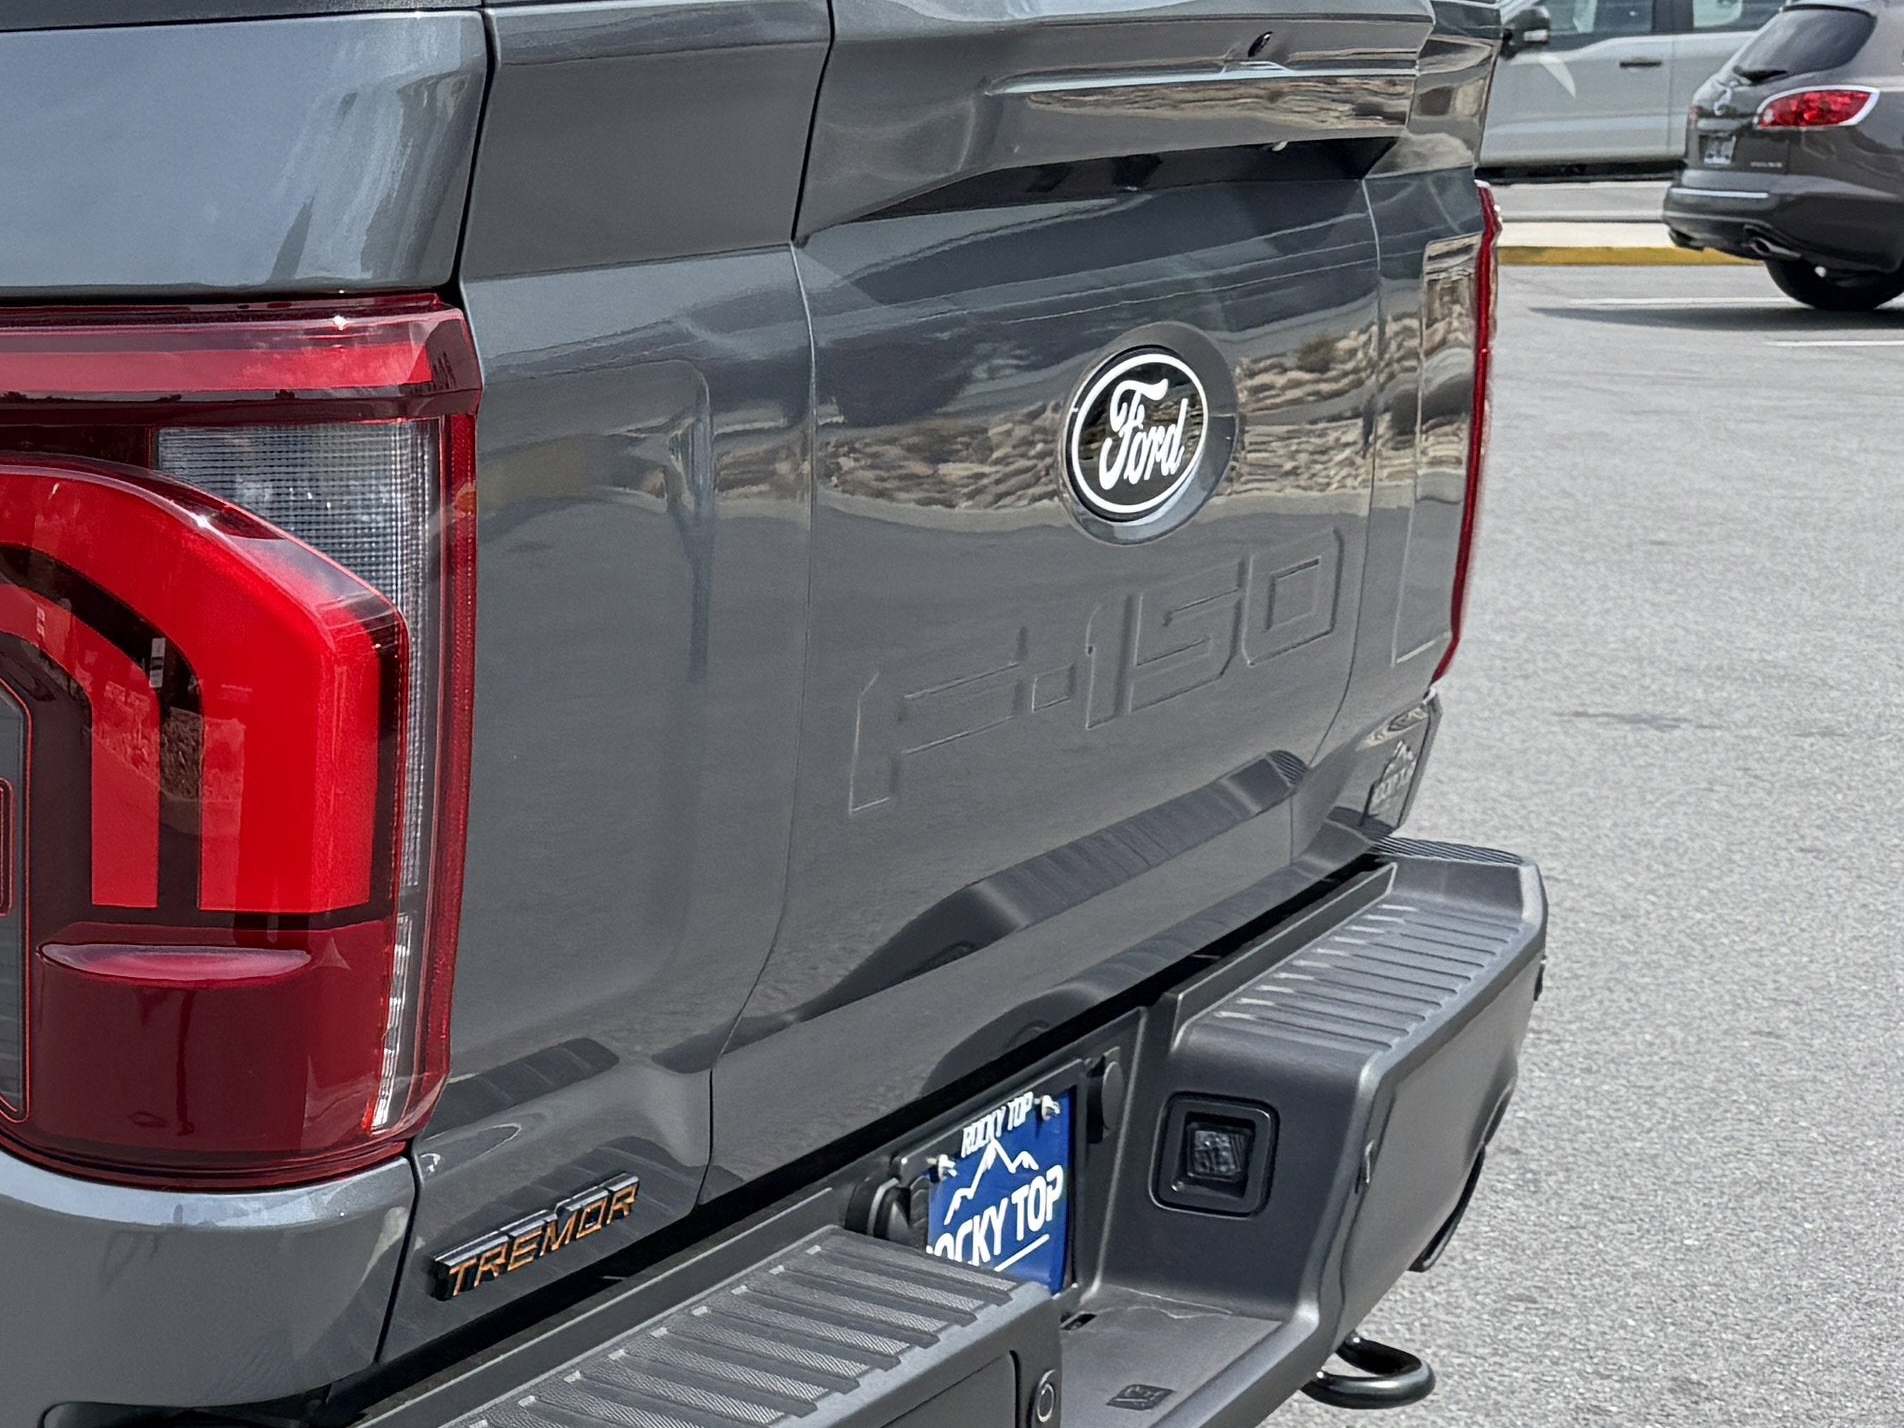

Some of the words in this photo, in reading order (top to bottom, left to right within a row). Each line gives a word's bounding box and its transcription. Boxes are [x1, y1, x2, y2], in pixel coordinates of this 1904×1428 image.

[1098, 378, 1189, 490] Ford
[960, 1105, 1006, 1159] ROCKY
[1007, 1091, 1034, 1131] TOP
[448, 1181, 639, 1297] TREMOR
[926, 1197, 1008, 1267] OCKY
[1011, 1164, 1064, 1242] TOP
